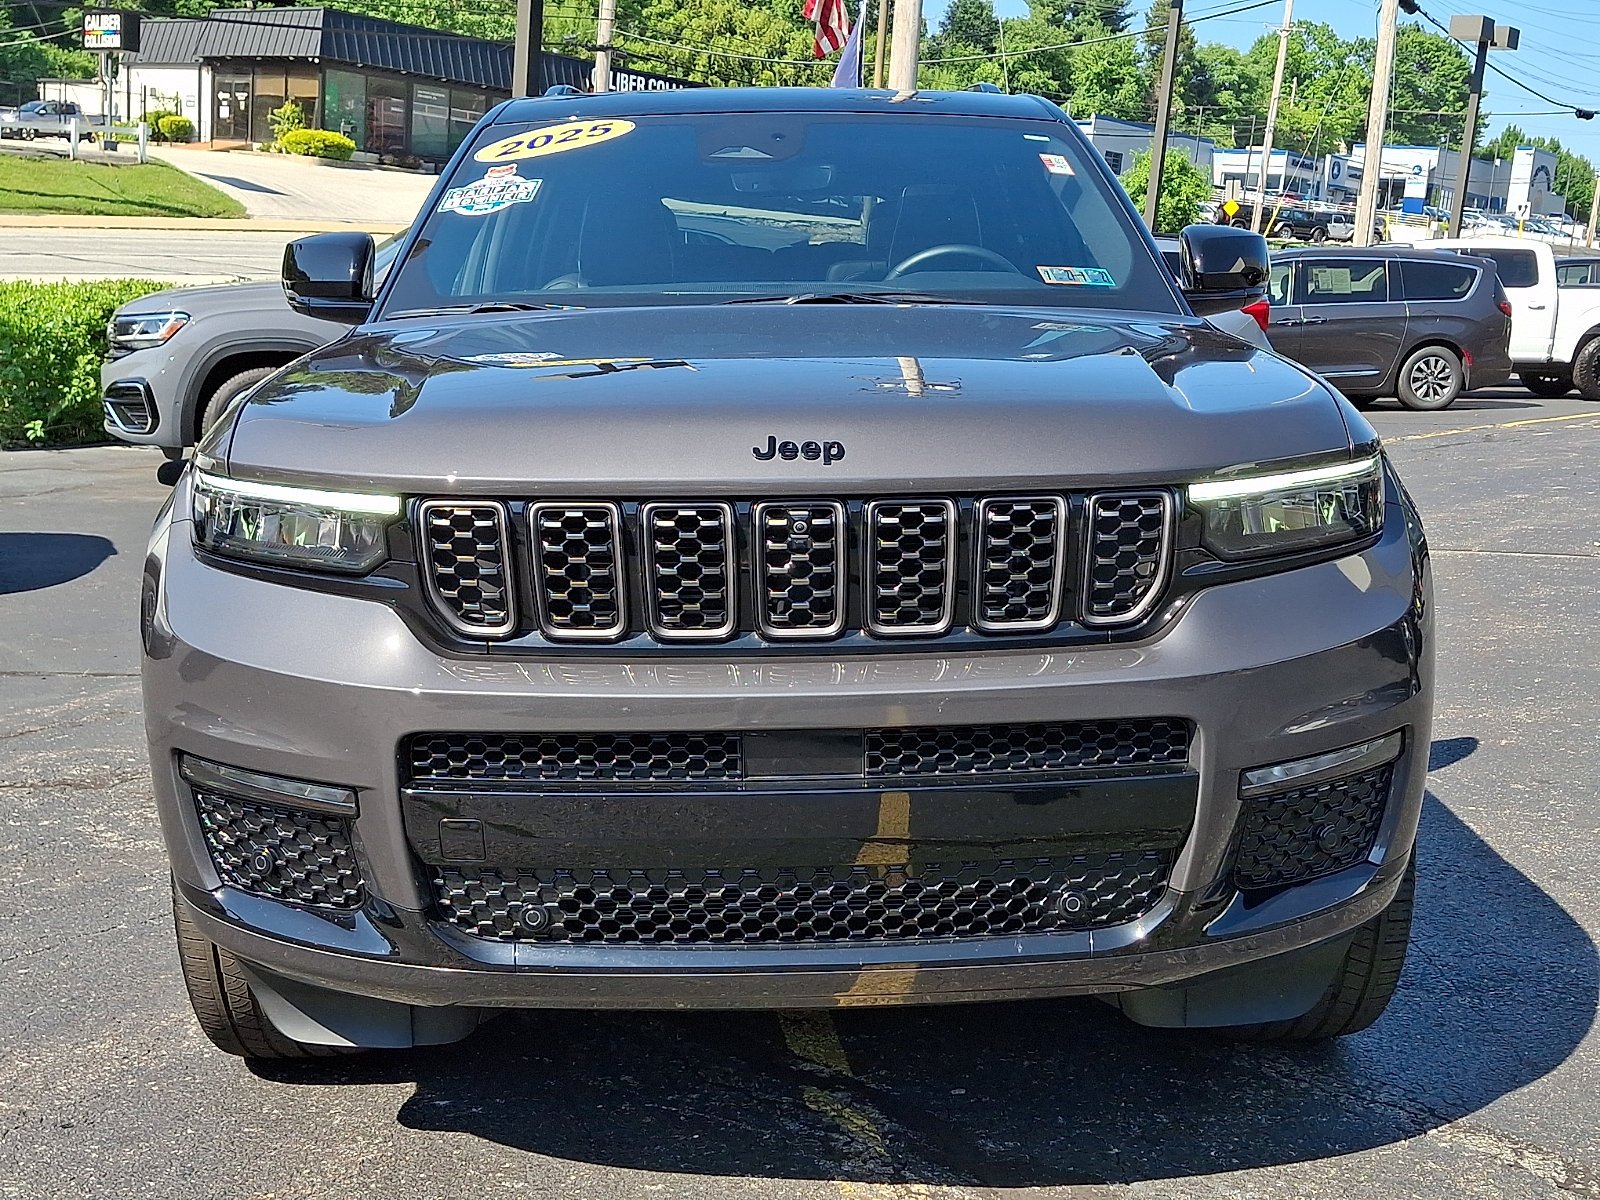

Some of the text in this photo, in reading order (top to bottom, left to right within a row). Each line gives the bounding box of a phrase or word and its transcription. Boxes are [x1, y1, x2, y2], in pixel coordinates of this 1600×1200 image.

[84, 13, 121, 31] CALIBER
[84, 34, 121, 48] COLLISION
[591, 68, 646, 92] CLIBER
[495, 122, 614, 158] 2025
[752, 435, 846, 466] Jeep
